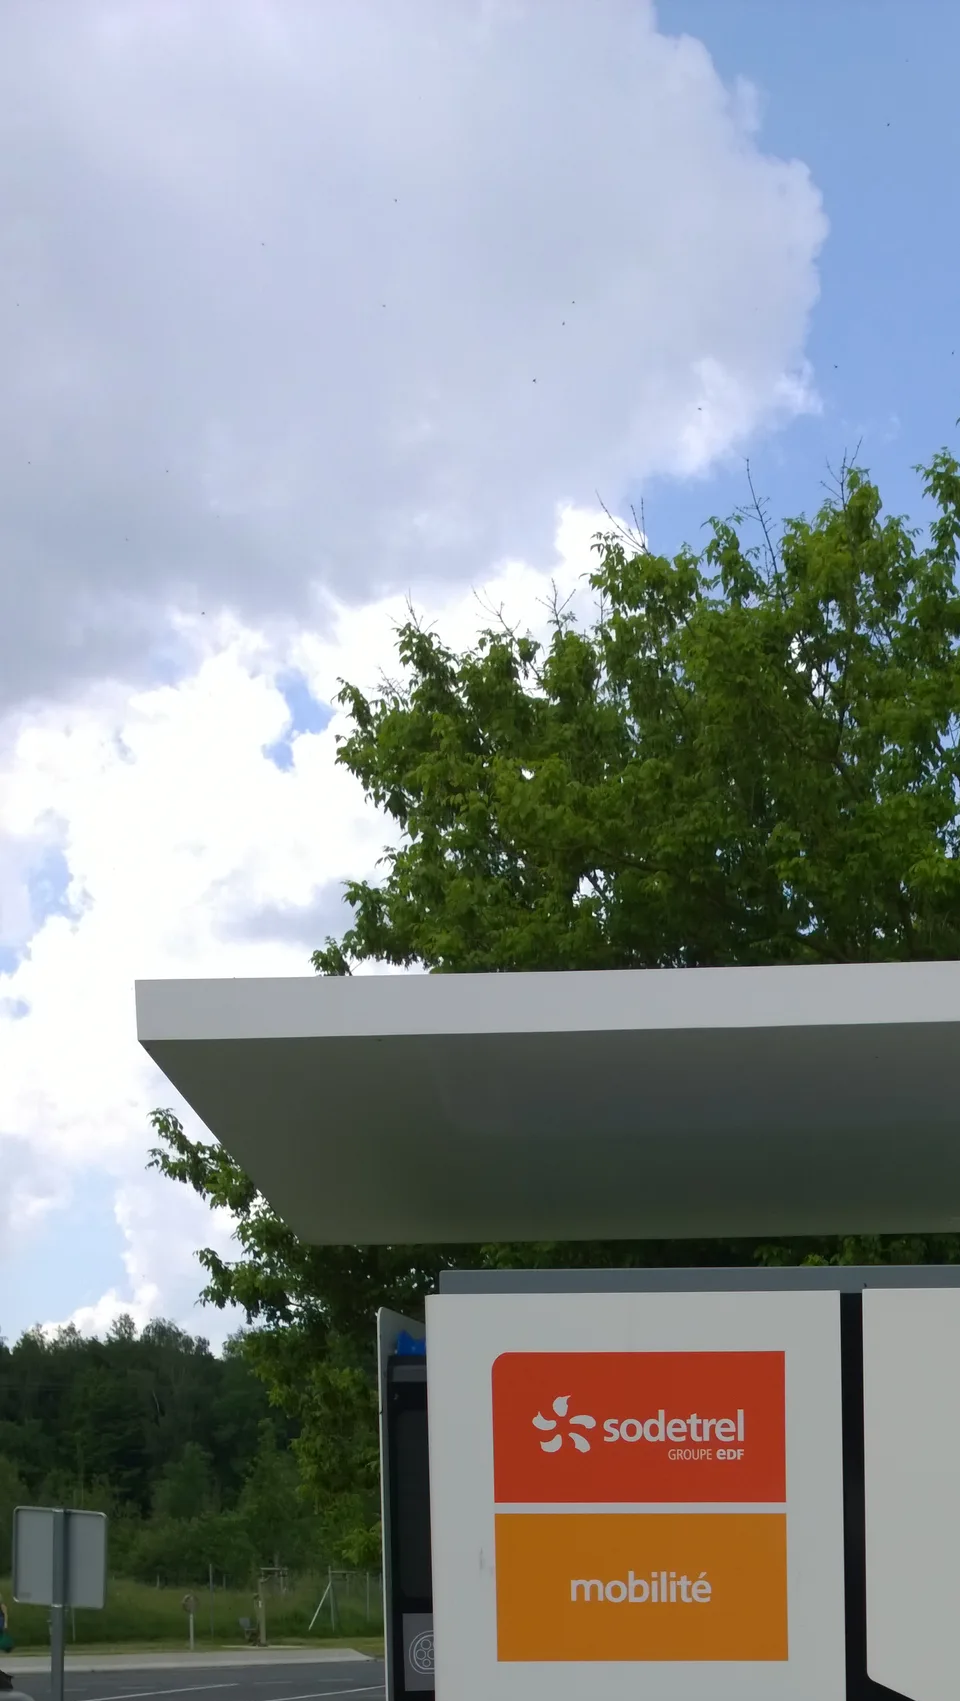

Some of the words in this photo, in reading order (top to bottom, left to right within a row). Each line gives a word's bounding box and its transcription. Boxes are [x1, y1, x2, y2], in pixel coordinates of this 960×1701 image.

[603, 1409, 744, 1442] sodetrel
[668, 1449, 712, 1460] GROUPE
[570, 1571, 712, 1603] mobilité
